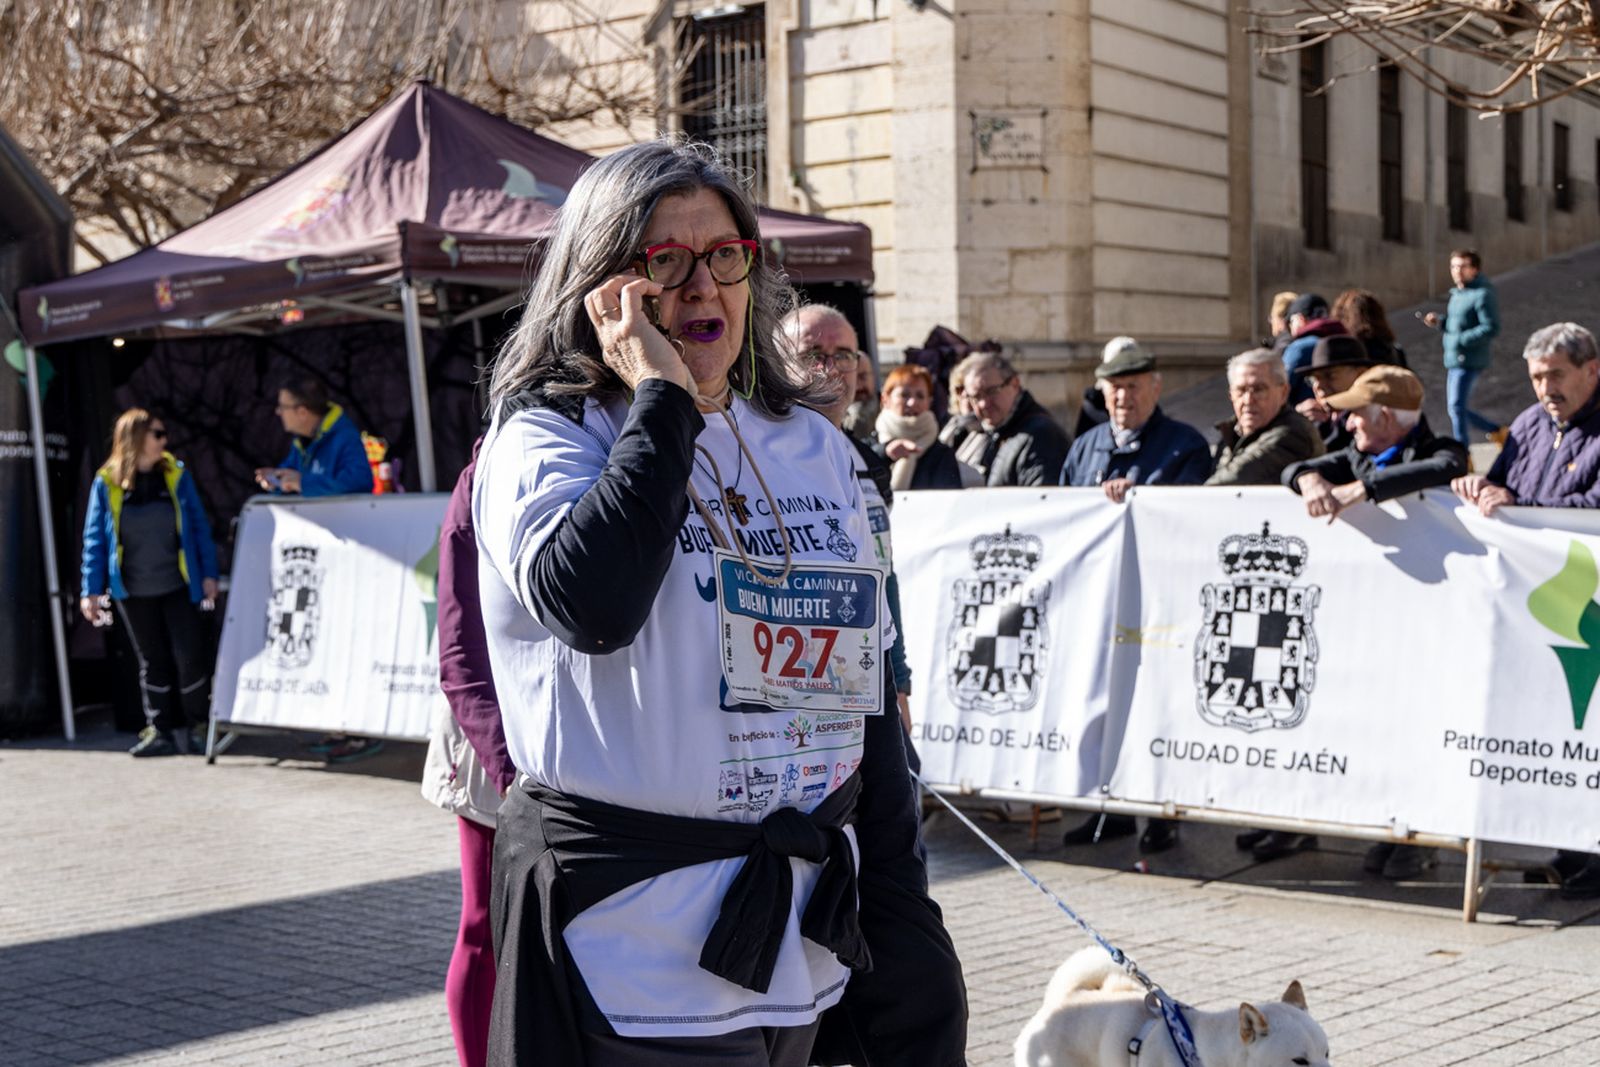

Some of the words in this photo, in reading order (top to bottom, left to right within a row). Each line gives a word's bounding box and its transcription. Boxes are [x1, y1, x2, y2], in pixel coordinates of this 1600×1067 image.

[756, 494, 841, 516] CMINATA
[678, 523, 722, 554] BUE
[736, 525, 823, 557] MUERTE
[794, 577, 858, 592] CAMINATA
[738, 588, 769, 616] BUENA
[771, 597, 830, 619] MUERTE
[753, 622, 840, 678] 927
[911, 722, 984, 745] CIUDAD
[990, 729, 1016, 748] DE
[1021, 728, 1071, 751] JAÉN
[1443, 730, 1553, 759] Patronato
[1562, 740, 1599, 763] Mu
[1149, 738, 1239, 764] CIUDAD
[1246, 747, 1278, 769] DE
[1284, 748, 1347, 775] JAÉN
[1469, 758, 1577, 787] Deportes
